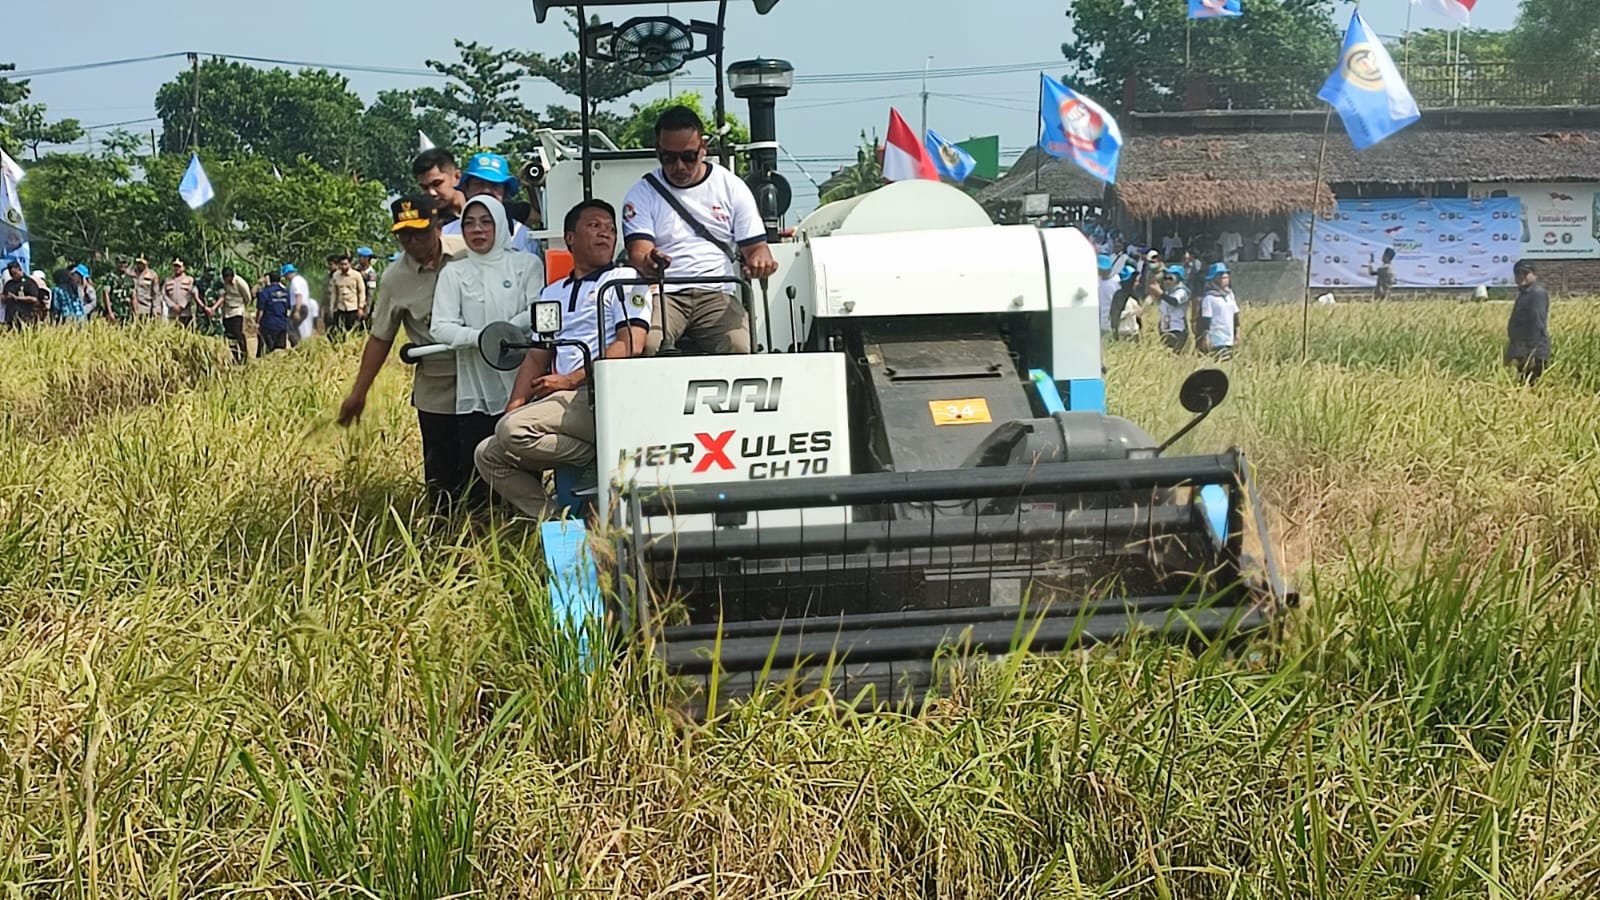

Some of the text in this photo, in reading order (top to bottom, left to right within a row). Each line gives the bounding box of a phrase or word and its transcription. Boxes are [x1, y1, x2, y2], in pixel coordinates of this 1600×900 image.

[683, 377, 783, 415] RAI
[749, 457, 828, 480] CH 70
